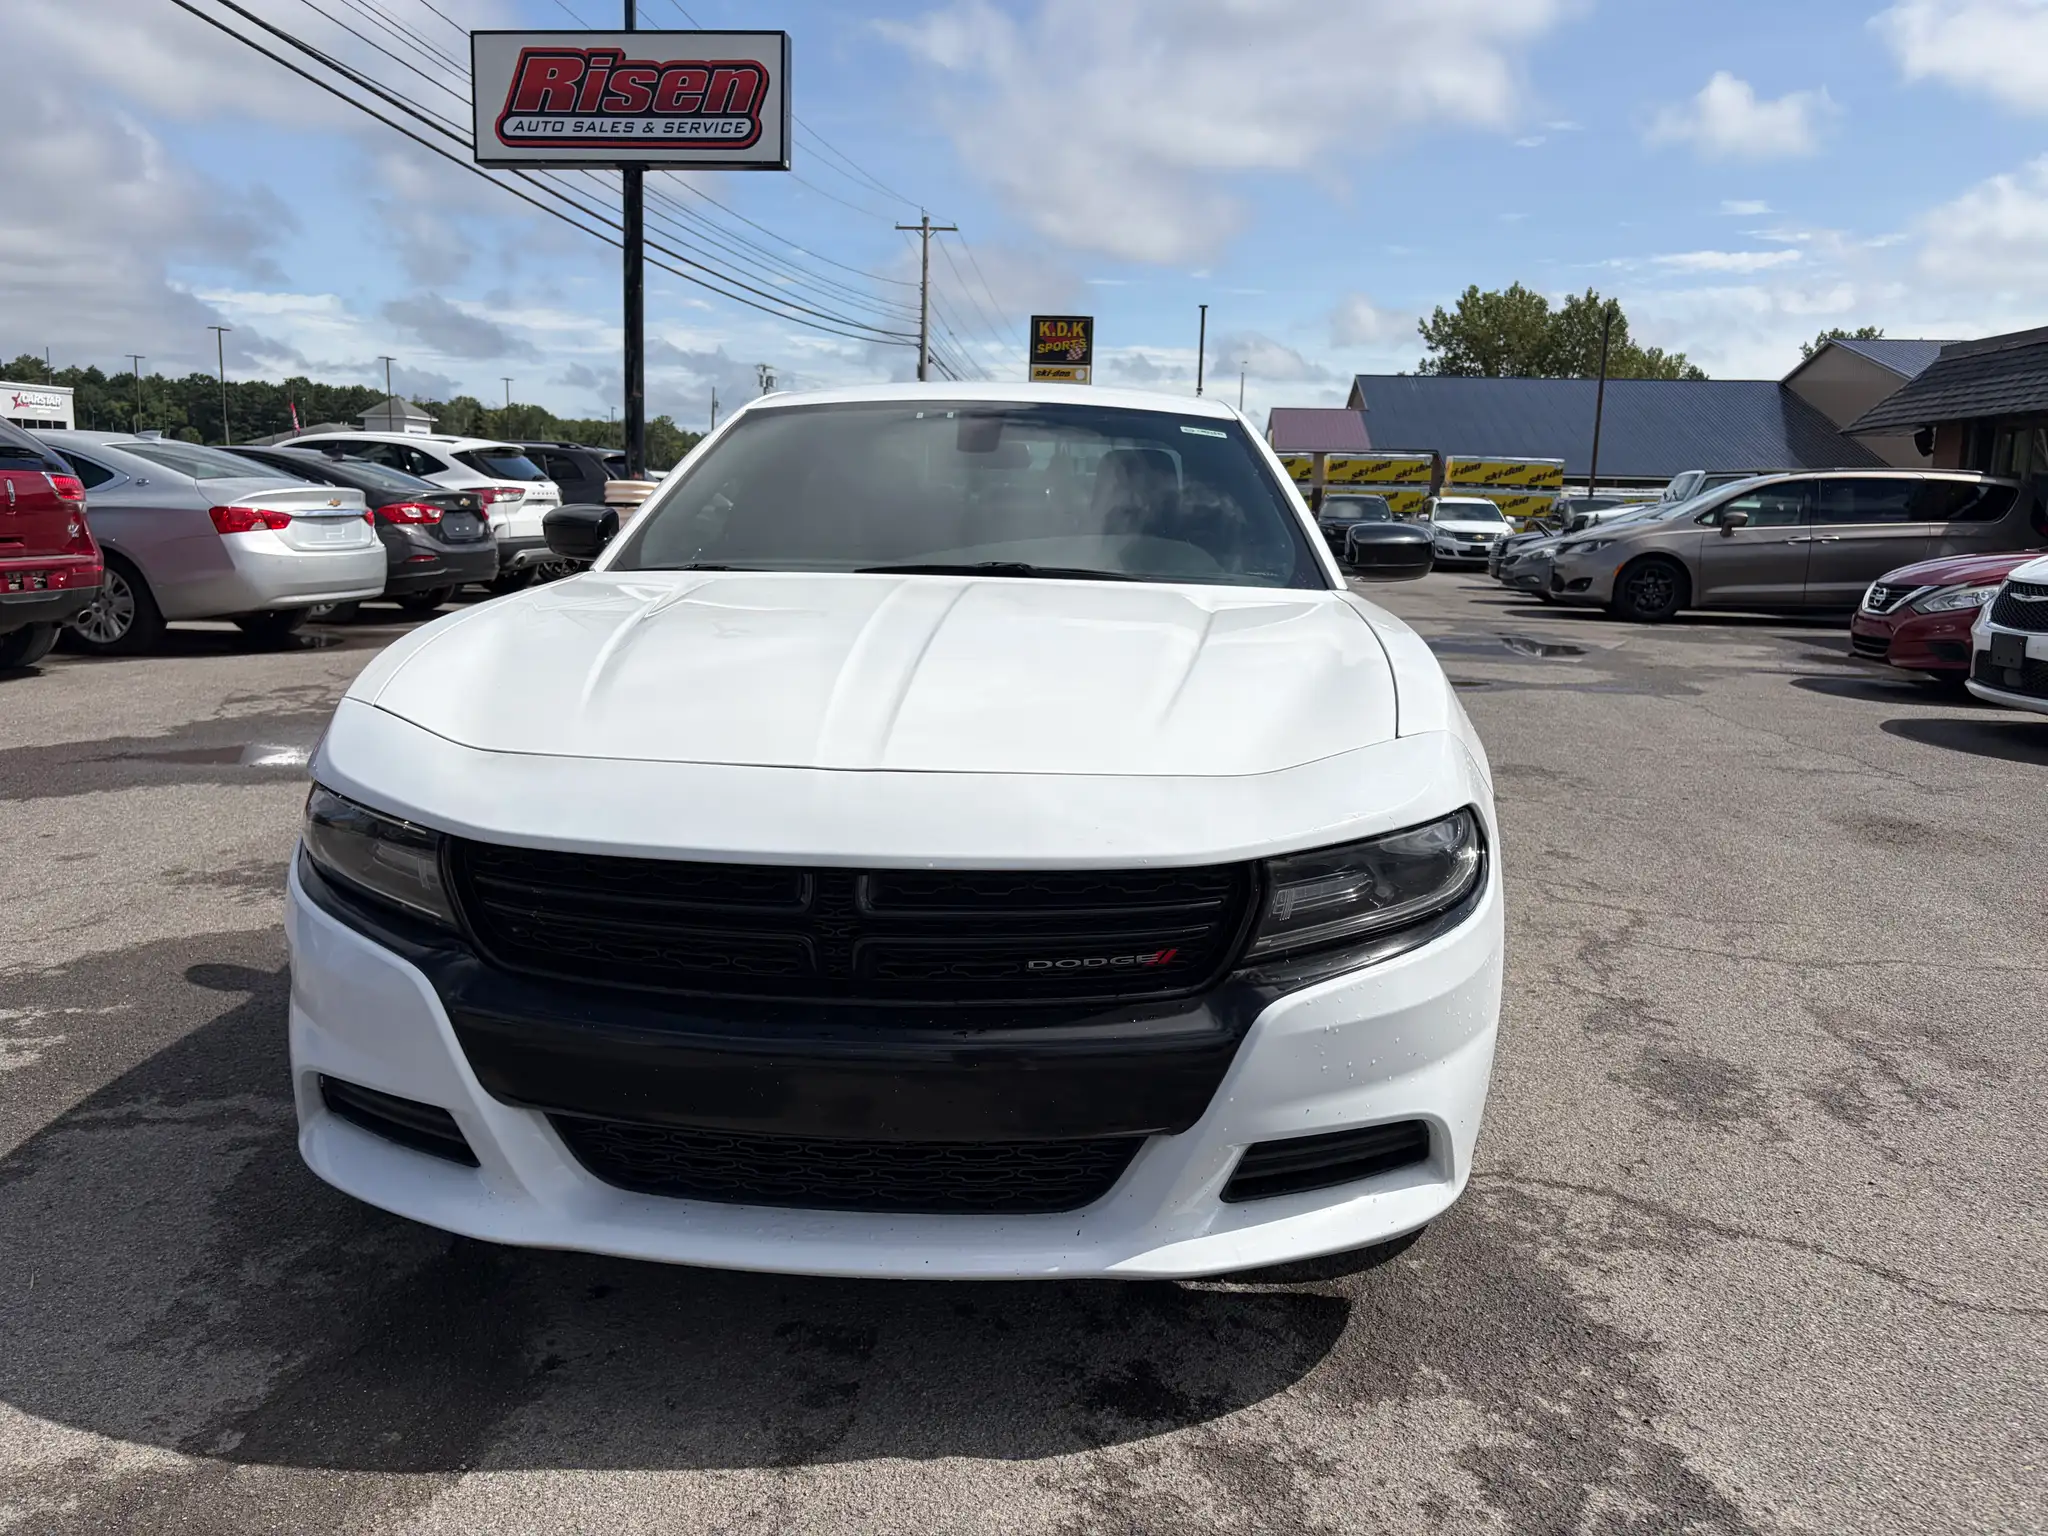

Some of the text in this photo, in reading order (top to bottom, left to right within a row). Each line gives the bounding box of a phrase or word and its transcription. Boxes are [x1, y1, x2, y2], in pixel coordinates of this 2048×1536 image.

[511, 56, 759, 114] Risen
[513, 120, 746, 134] AUTO SALES & SERVICE
[1037, 338, 1087, 354] SPORTS
[1028, 953, 1159, 969] DODGE
